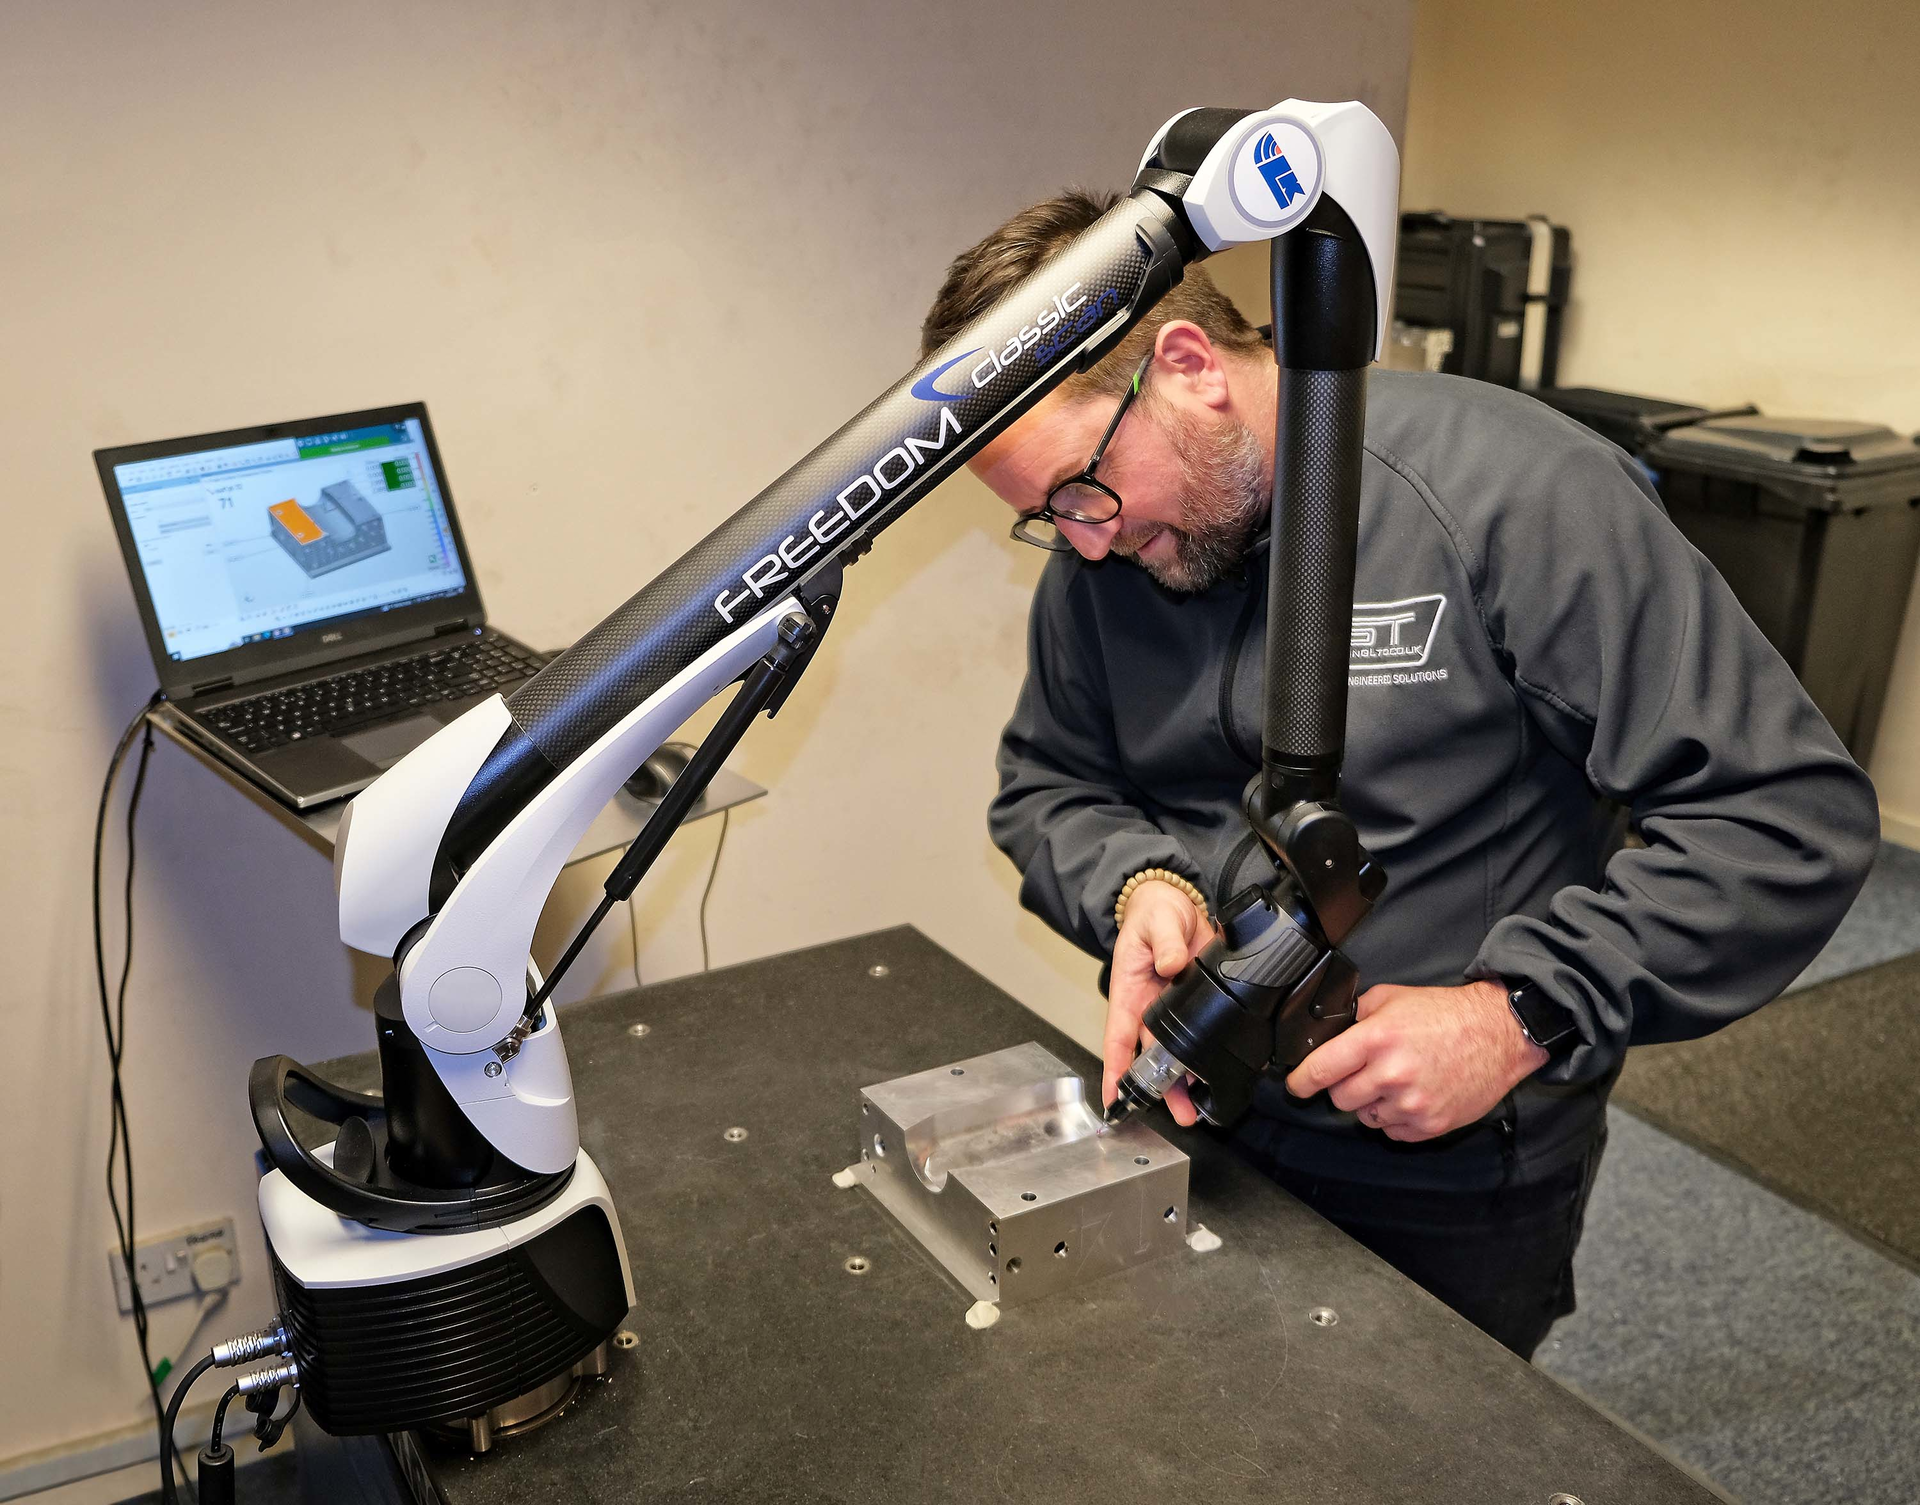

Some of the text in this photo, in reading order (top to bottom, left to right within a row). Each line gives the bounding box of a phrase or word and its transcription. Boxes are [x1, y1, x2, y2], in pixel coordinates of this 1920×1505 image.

[971, 282, 1087, 389] classic
[1035, 288, 1118, 367] scan
[714, 406, 962, 623] FREEDOM
[1348, 668, 1448, 686] NGINEERED SOLUTIONS
